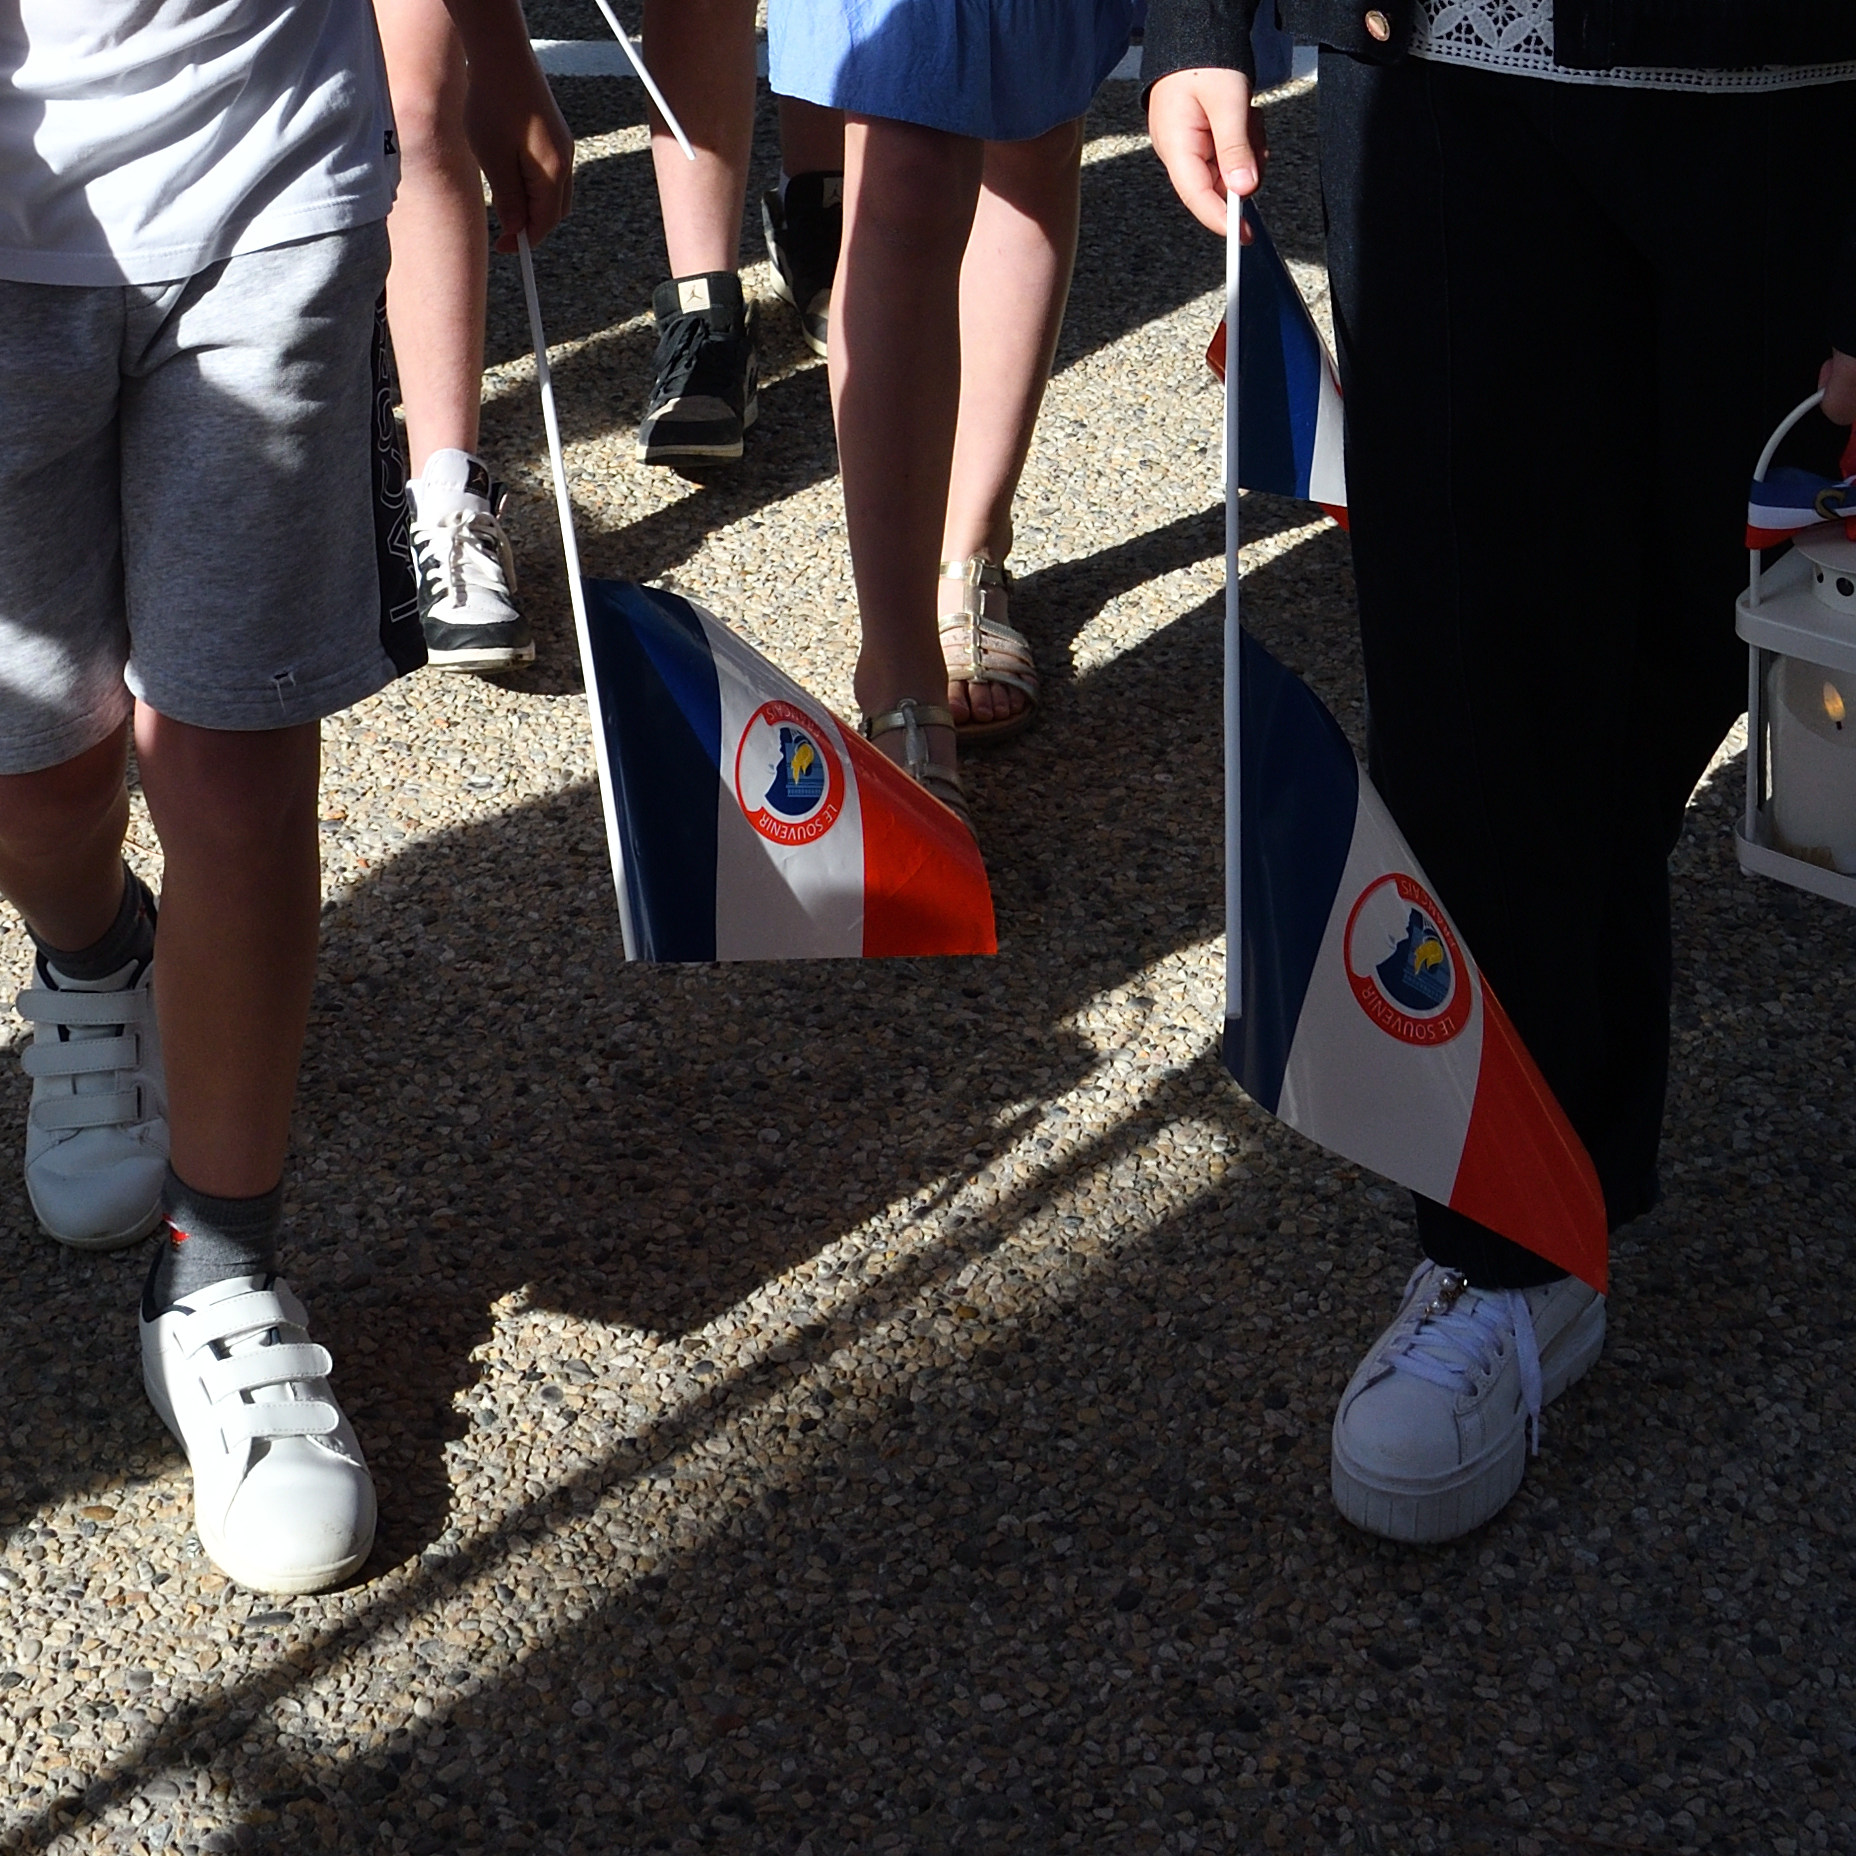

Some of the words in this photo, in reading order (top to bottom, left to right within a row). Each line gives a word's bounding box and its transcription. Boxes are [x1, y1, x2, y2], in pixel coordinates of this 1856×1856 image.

[822, 804, 838, 823] LE
[758, 812, 824, 841] SOUVENIR
[1361, 984, 1435, 1039] SOUVENIR
[1439, 1016, 1456, 1035] LE
